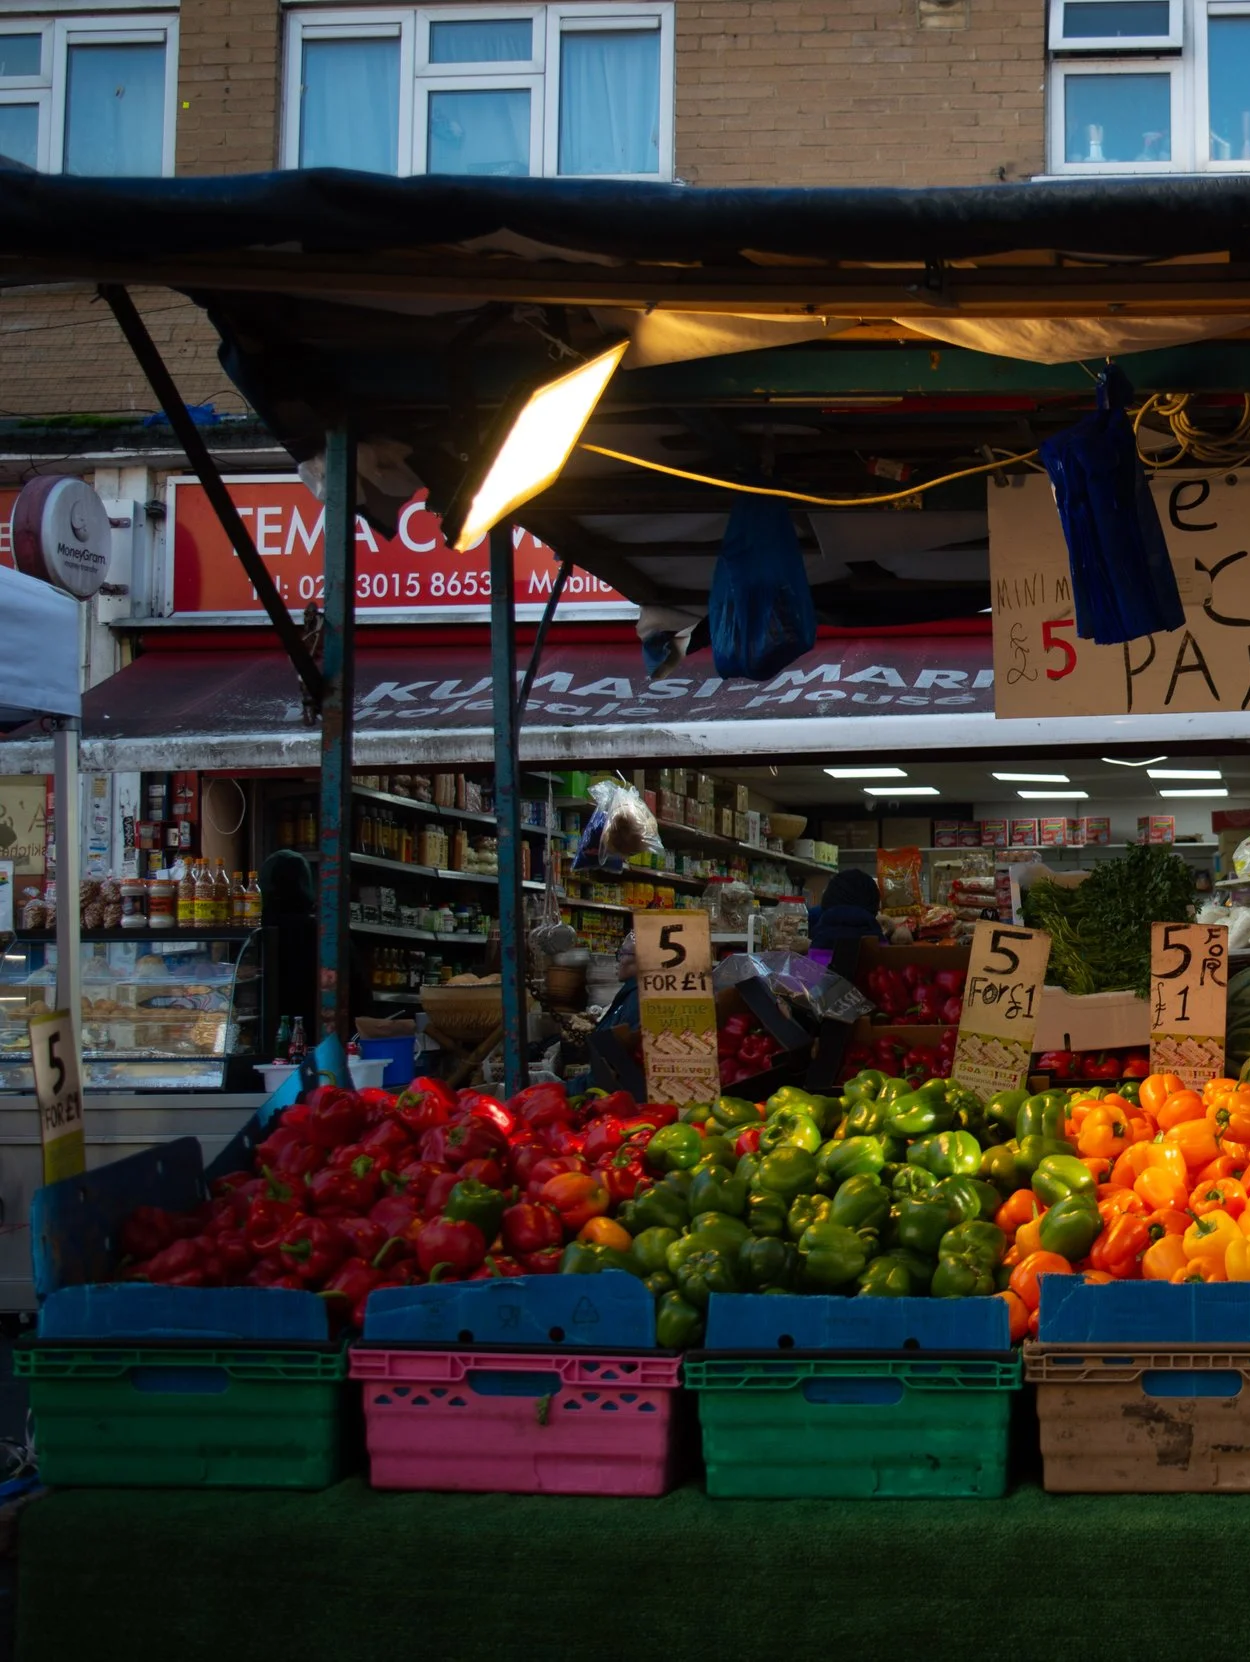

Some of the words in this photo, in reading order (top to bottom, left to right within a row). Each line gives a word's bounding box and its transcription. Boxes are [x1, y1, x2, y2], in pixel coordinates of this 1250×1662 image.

[57, 541, 106, 567] MoneyGram
[357, 571, 421, 597] 3015
[429, 569, 492, 596] 8653
[659, 924, 686, 969] 5
[983, 929, 1033, 975] 5
[1151, 924, 1192, 979] 5
[643, 974, 677, 992] FOR
[682, 971, 706, 991] £1
[49, 1031, 66, 1095] 5
